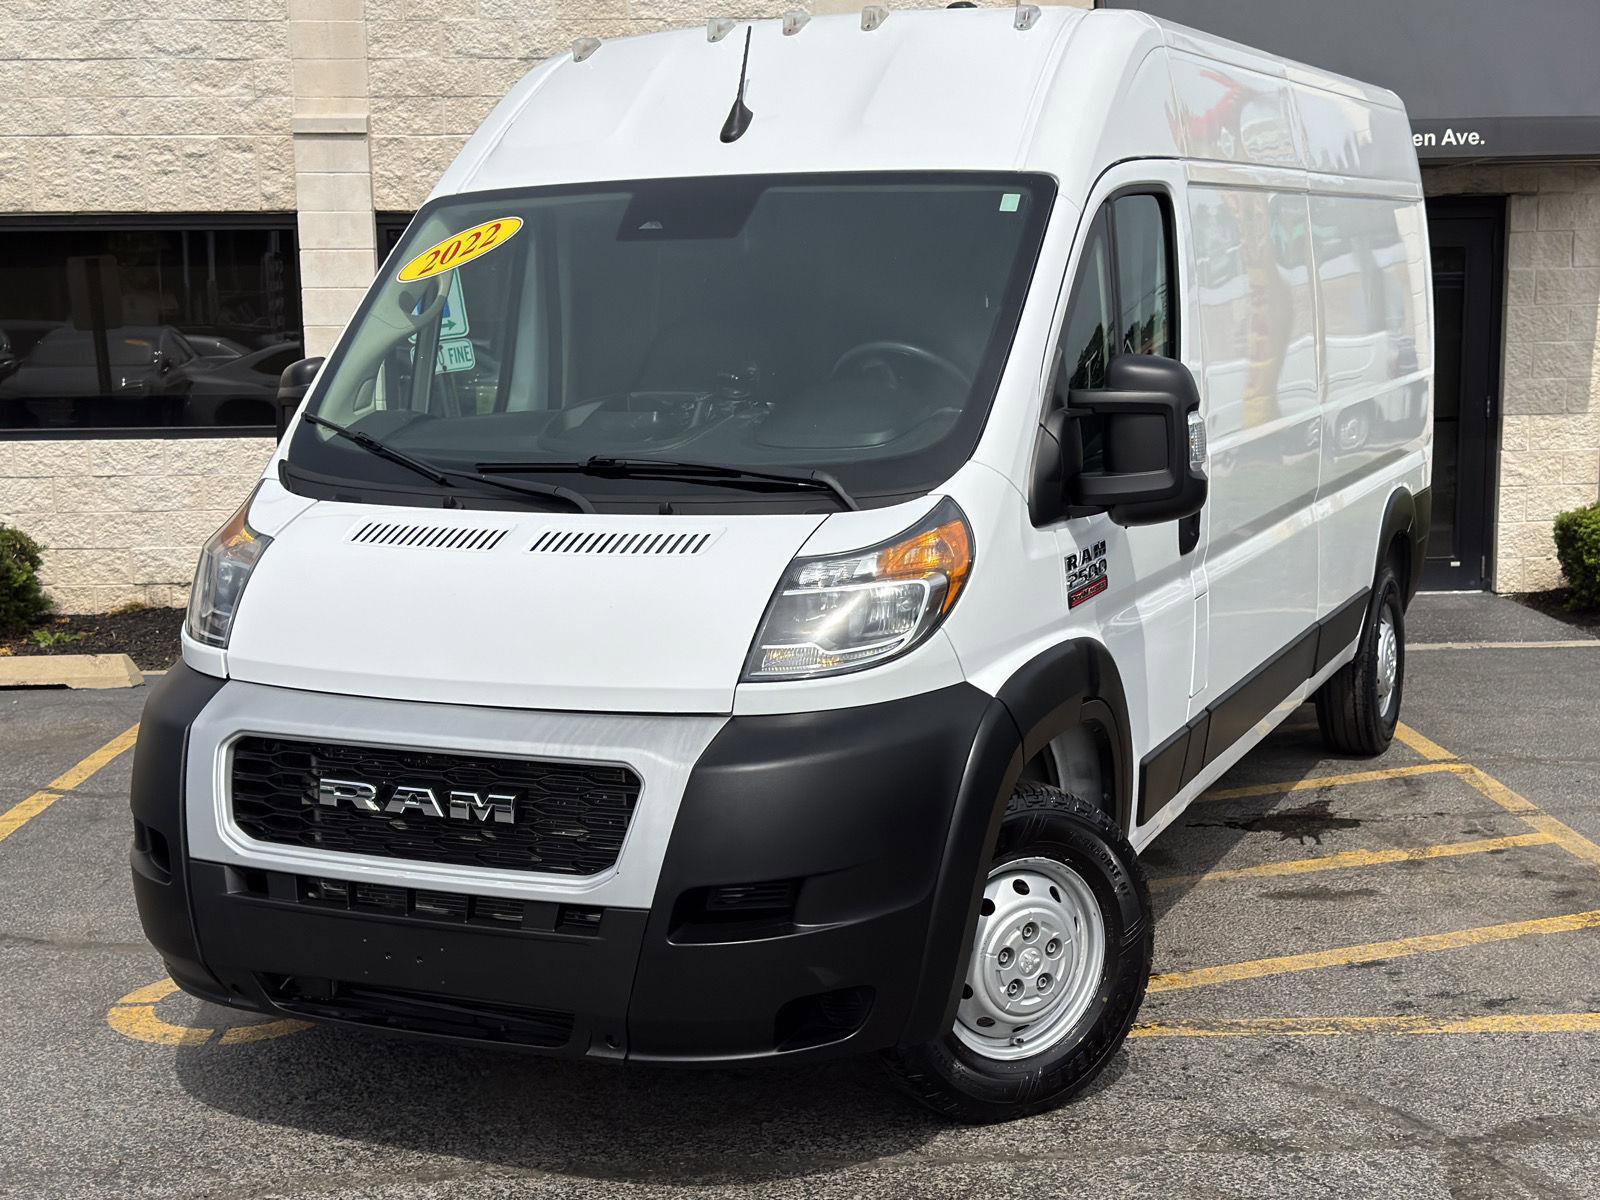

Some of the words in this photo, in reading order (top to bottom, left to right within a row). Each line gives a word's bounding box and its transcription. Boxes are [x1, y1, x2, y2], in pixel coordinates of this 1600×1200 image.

[1412, 132, 1436, 147] en
[1441, 128, 1486, 146] Ave.
[417, 223, 502, 276] 2022
[447, 345, 472, 365] FINE
[1064, 539, 1107, 573] RAM
[1066, 557, 1108, 589] 2500
[319, 778, 517, 825] RAM
